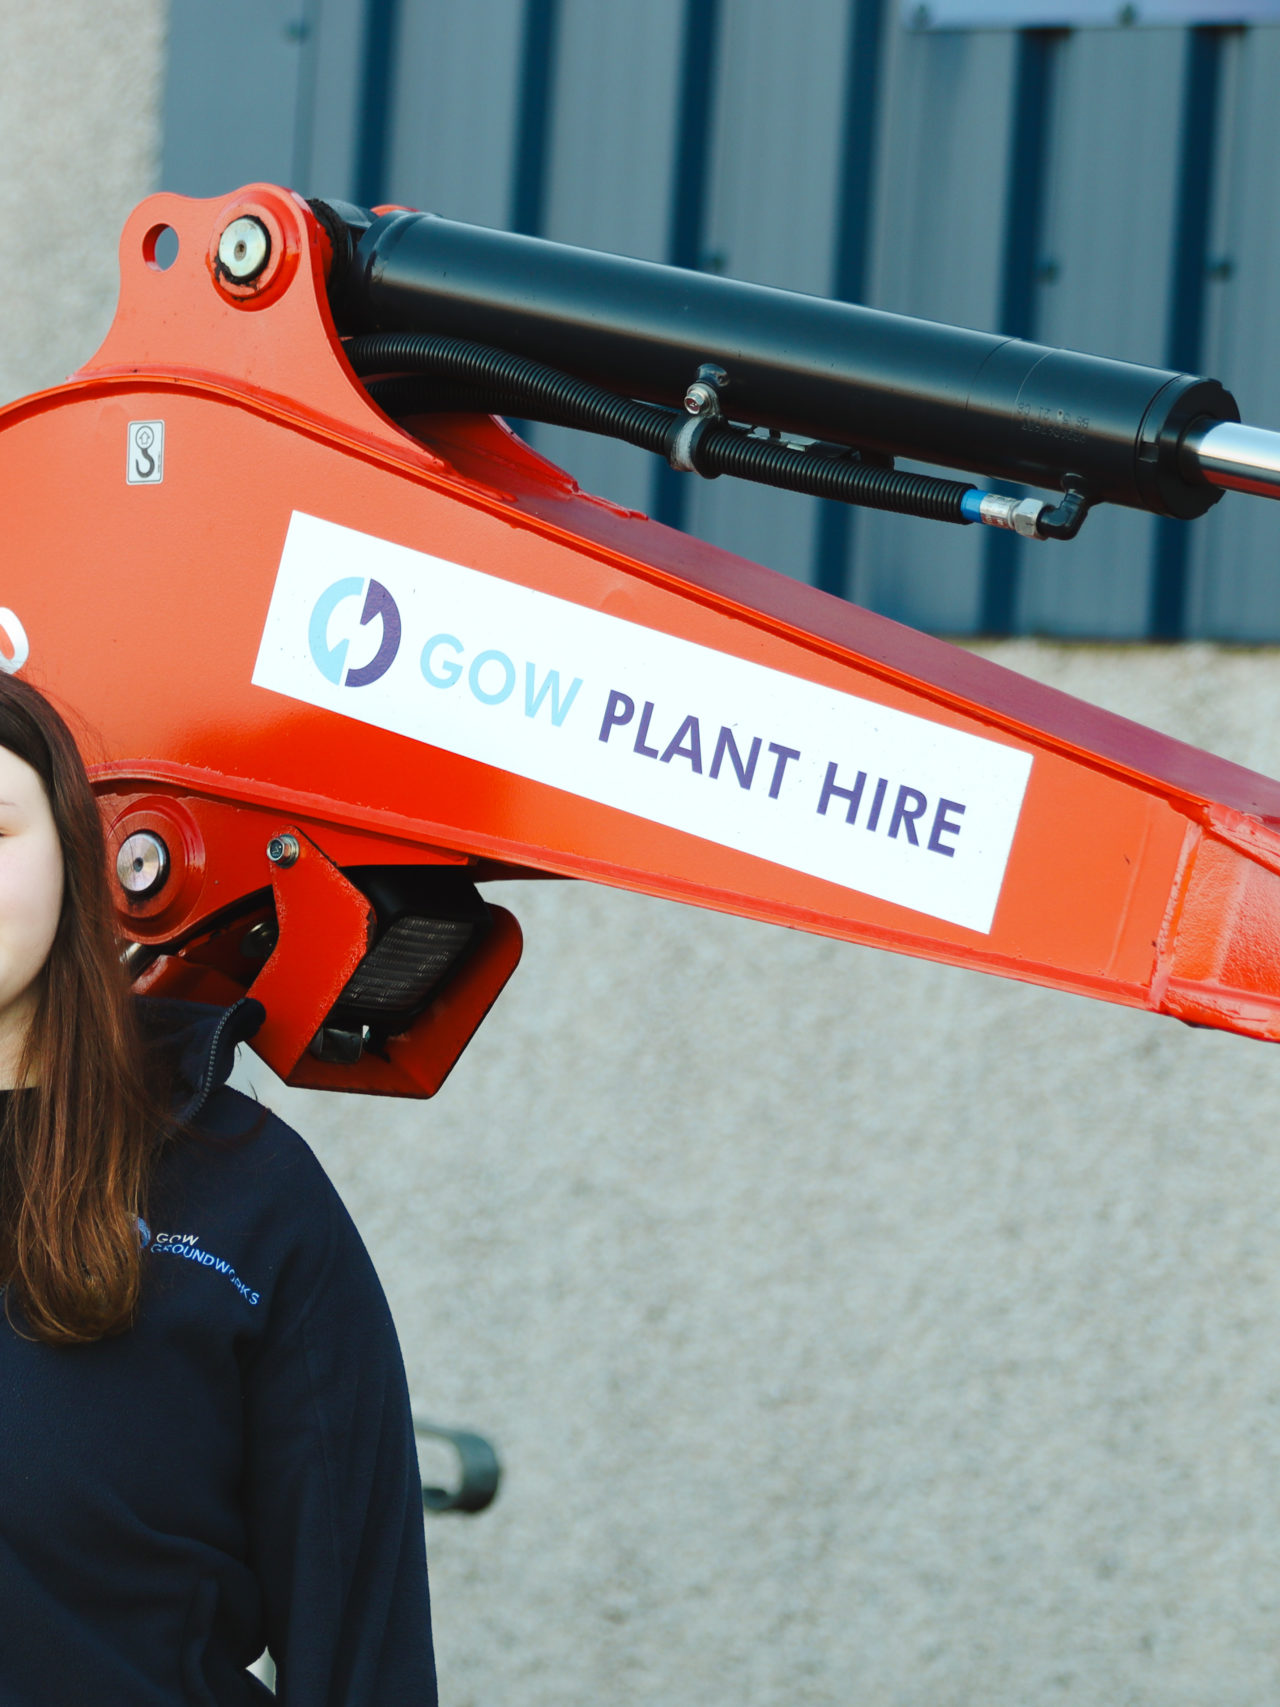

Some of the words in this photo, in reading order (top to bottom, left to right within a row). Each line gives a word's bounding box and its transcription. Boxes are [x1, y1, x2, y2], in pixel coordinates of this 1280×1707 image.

[420, 633, 584, 727] GOW
[598, 689, 801, 800] PLANT
[816, 761, 966, 858] HIRE
[156, 1233, 199, 1245] GOW
